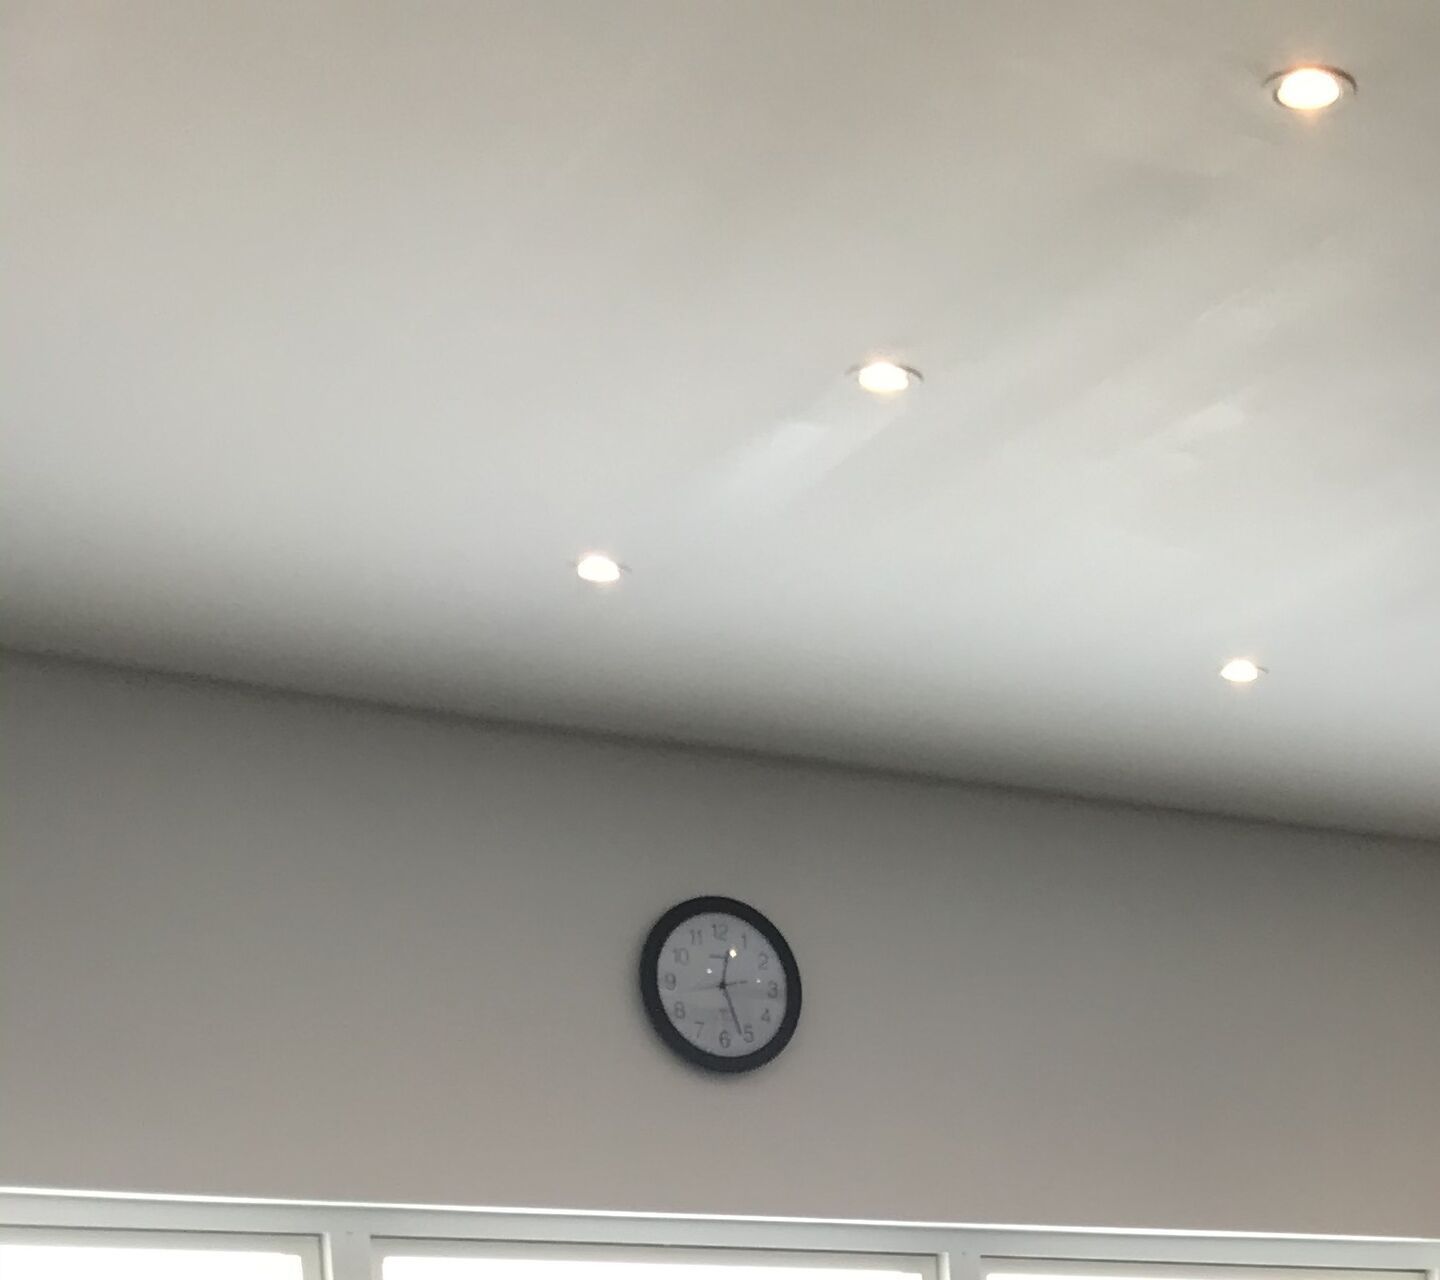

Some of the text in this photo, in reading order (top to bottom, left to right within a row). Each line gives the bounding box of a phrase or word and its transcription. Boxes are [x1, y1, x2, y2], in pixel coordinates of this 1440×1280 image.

[690, 929, 703, 946] 11
[712, 924, 728, 941] 12
[741, 933, 748, 948] 1
[673, 948, 689, 966] 10
[758, 952, 769, 970] 2
[664, 973, 676, 991] 9
[767, 980, 778, 999] 3
[674, 1001, 686, 1019] 8
[761, 1007, 771, 1023] 4
[694, 1021, 705, 1038] 7
[743, 1025, 754, 1043] 5
[719, 1030, 731, 1048] 6
